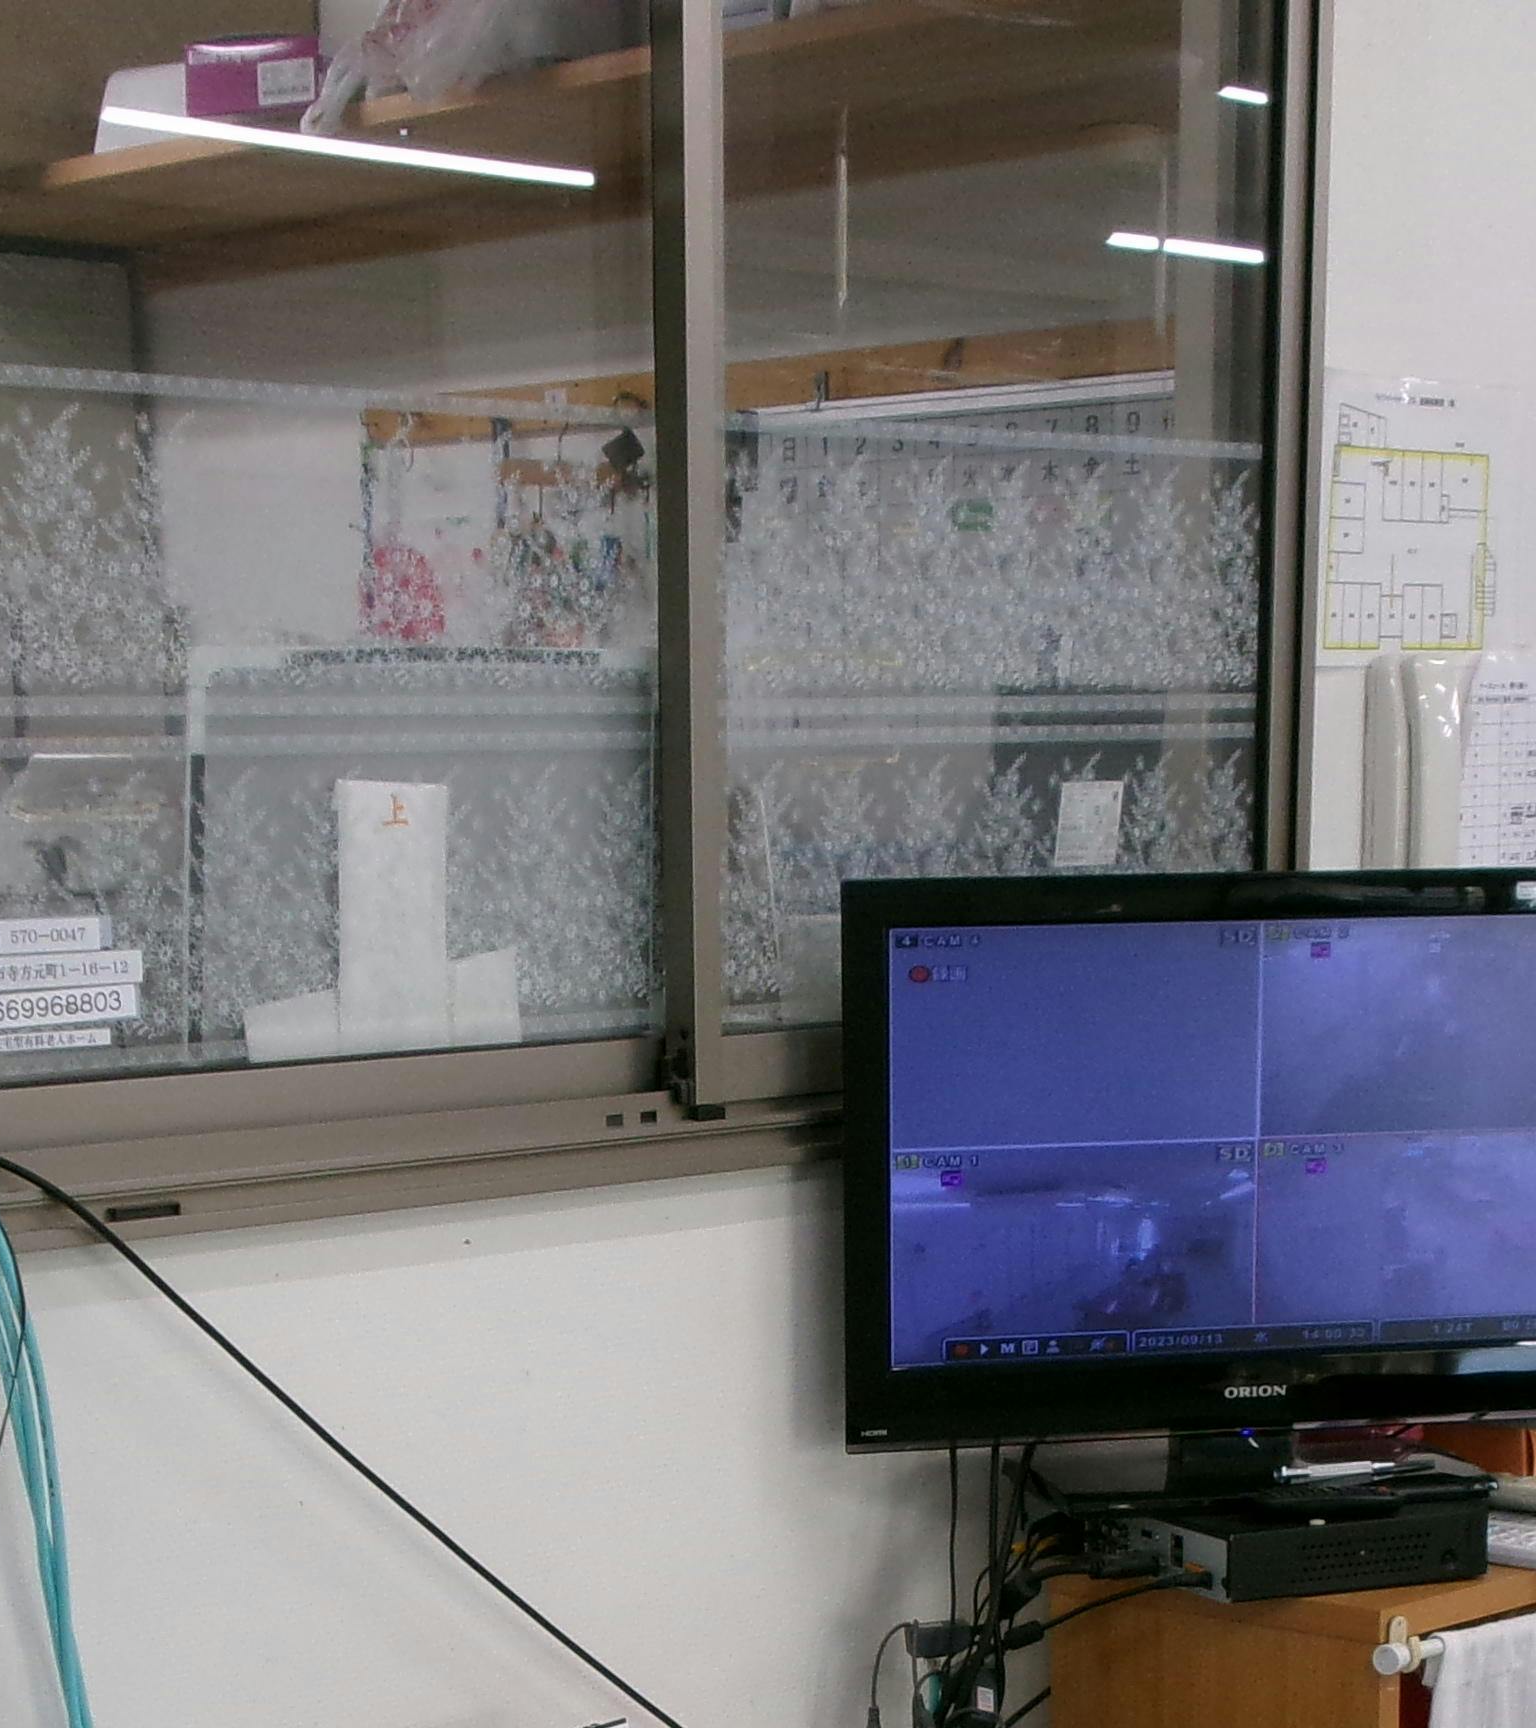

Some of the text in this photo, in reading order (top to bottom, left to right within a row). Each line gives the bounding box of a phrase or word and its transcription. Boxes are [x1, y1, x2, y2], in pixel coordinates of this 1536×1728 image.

[382, 793, 410, 826] 上
[9, 926, 87, 946] 570-0047
[921, 1154, 962, 1168] CAM
[1223, 1383, 1288, 1400] ORION
